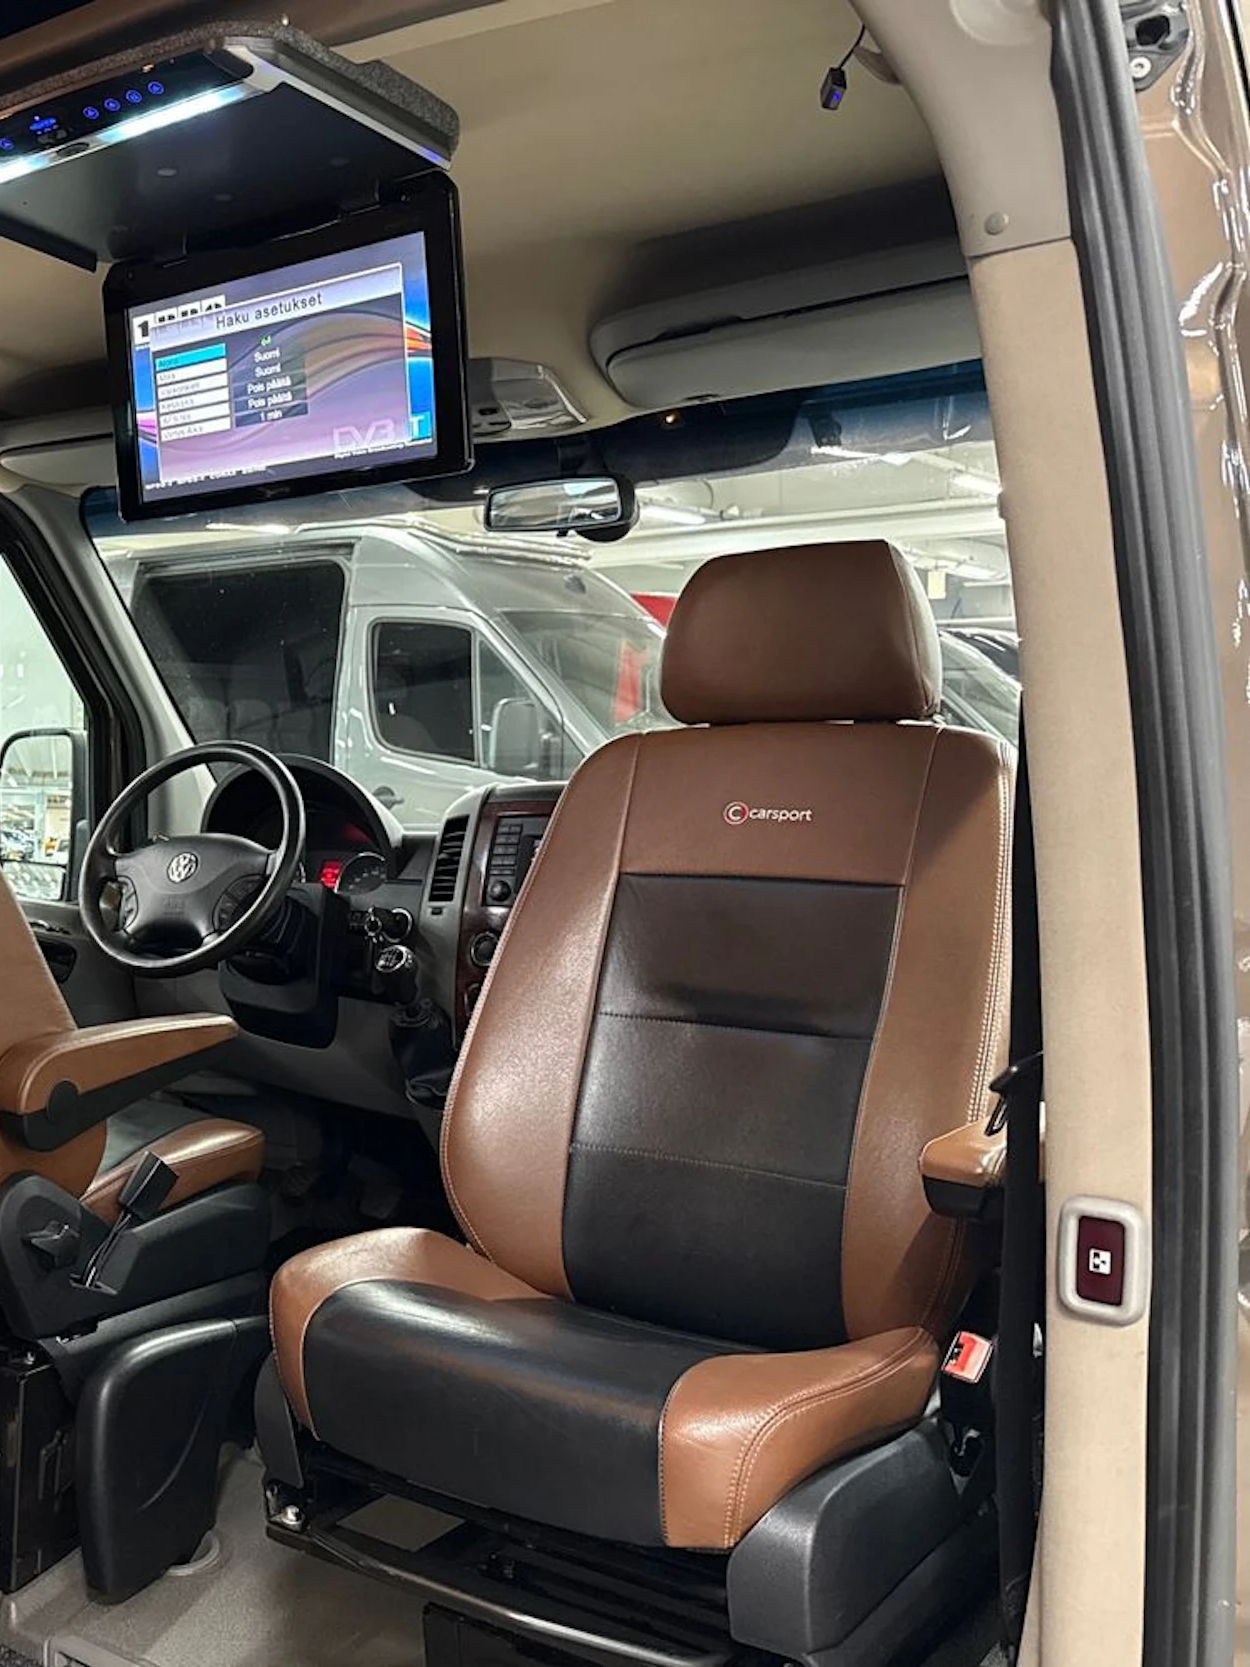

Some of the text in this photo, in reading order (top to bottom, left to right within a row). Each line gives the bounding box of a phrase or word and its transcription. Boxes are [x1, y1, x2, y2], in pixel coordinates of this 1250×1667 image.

[215, 308, 250, 330] Haku
[254, 293, 323, 321] asetukset
[254, 347, 280, 362] Suomi
[255, 363, 281, 377] Suomi
[749, 808, 813, 822] carsport
